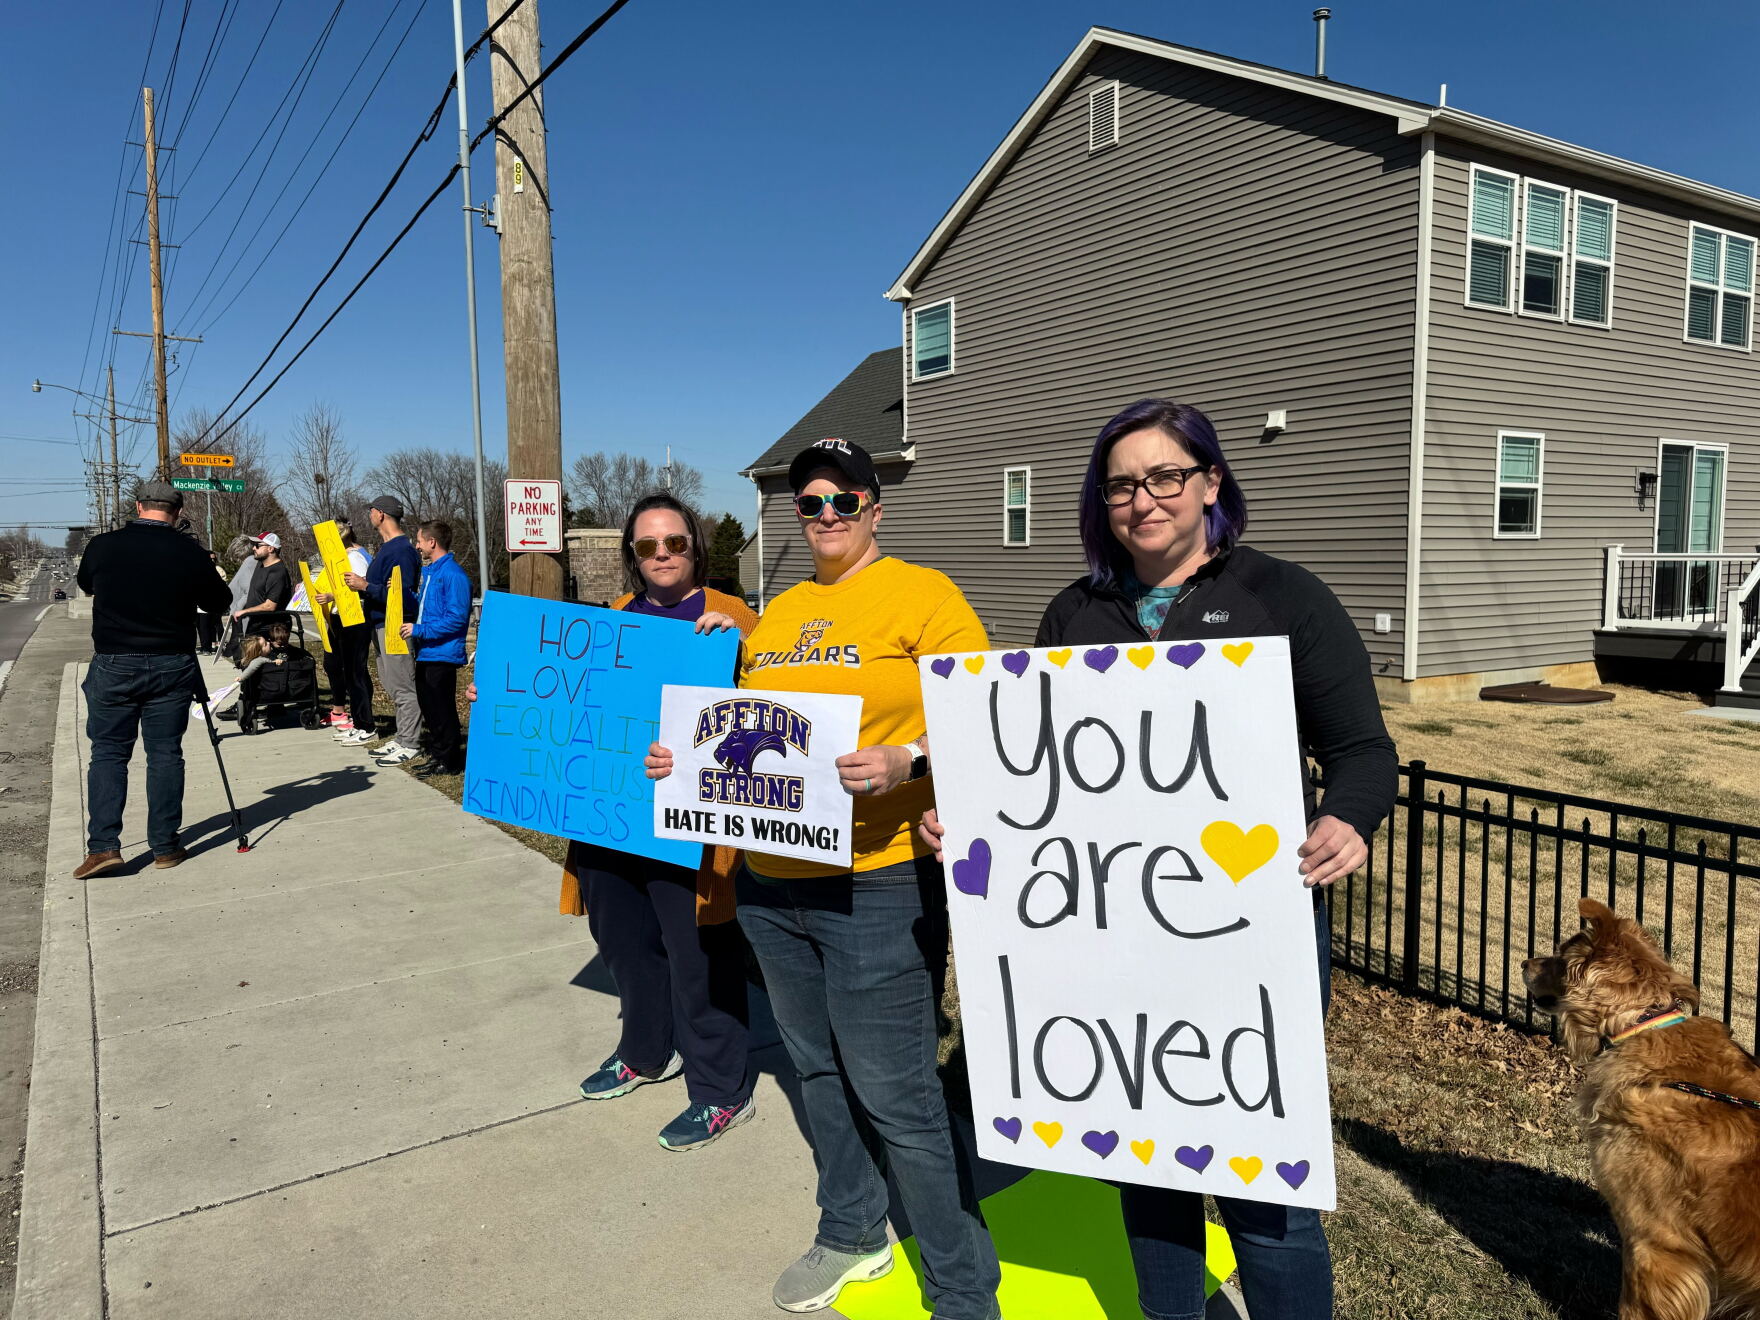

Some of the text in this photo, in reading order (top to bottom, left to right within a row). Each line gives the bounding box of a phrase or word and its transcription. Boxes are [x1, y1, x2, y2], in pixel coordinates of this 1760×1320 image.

[196, 456, 221, 464] OUTLET
[173, 480, 210, 489] Mackenzie
[524, 486, 542, 499] NO
[510, 501, 556, 516] PARKING
[525, 517, 542, 526] ANY
[524, 527, 544, 537] TIME
[539, 614, 641, 669] HOPE
[800, 619, 834, 630] AFFTON
[506, 661, 608, 708] LOVE
[694, 698, 812, 757] AFFTON
[519, 748, 655, 802] INCLUS
[699, 767, 804, 812] STRONG
[466, 772, 630, 842] KINDNESS
[664, 807, 839, 852] HATE IS WRONG!
[1017, 836, 1251, 940] are
[997, 954, 1286, 1119] loved
